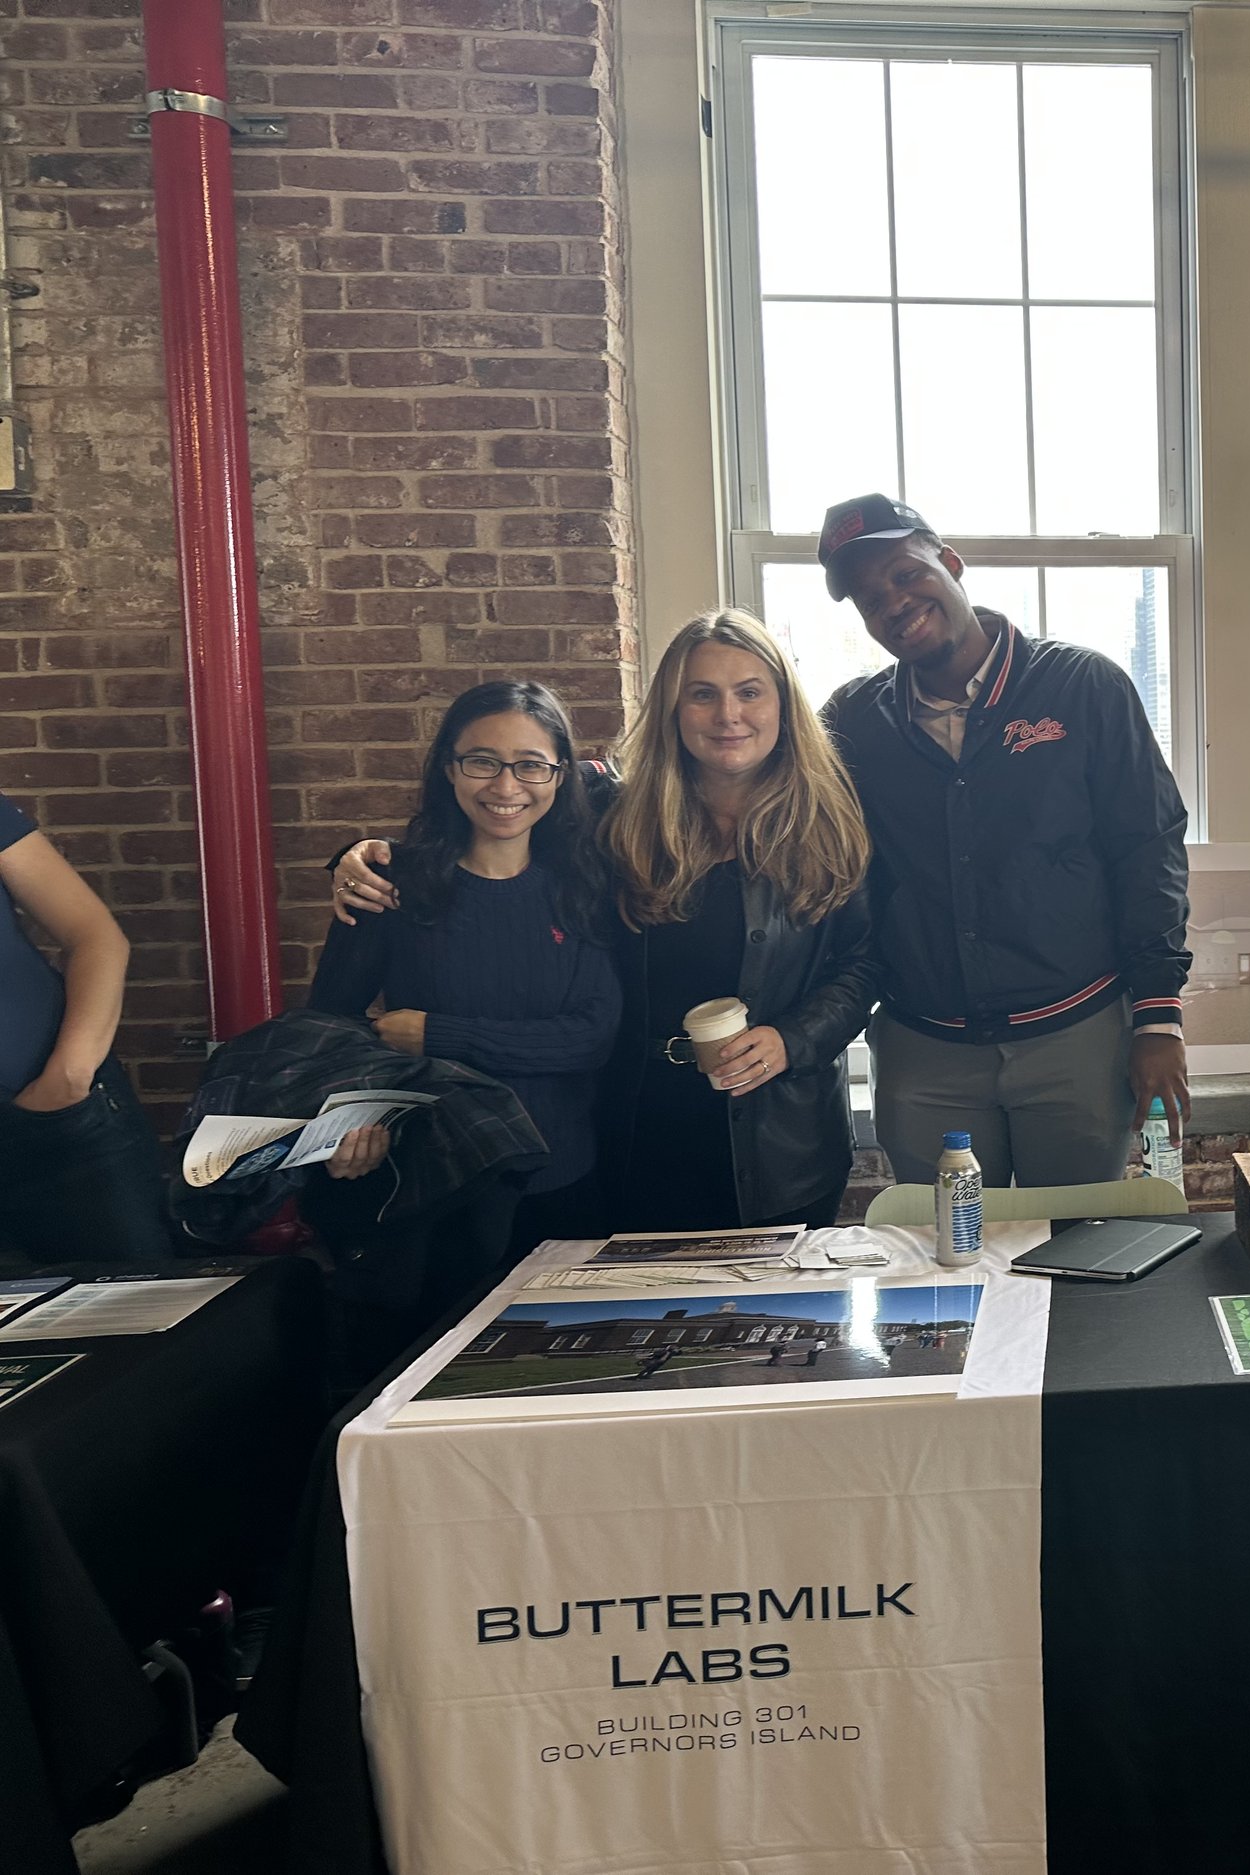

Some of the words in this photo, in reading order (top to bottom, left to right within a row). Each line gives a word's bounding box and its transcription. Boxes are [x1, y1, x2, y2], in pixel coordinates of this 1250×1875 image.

[1003, 716, 1066, 748] Polo
[477, 1582, 918, 1645] BUTTERMILK
[611, 1643, 792, 1690] LABS
[597, 1709, 743, 1737] BUILDING
[755, 1704, 808, 1724] 301
[540, 1732, 738, 1764] GOVERNORS
[750, 1724, 862, 1746] ISLAND
